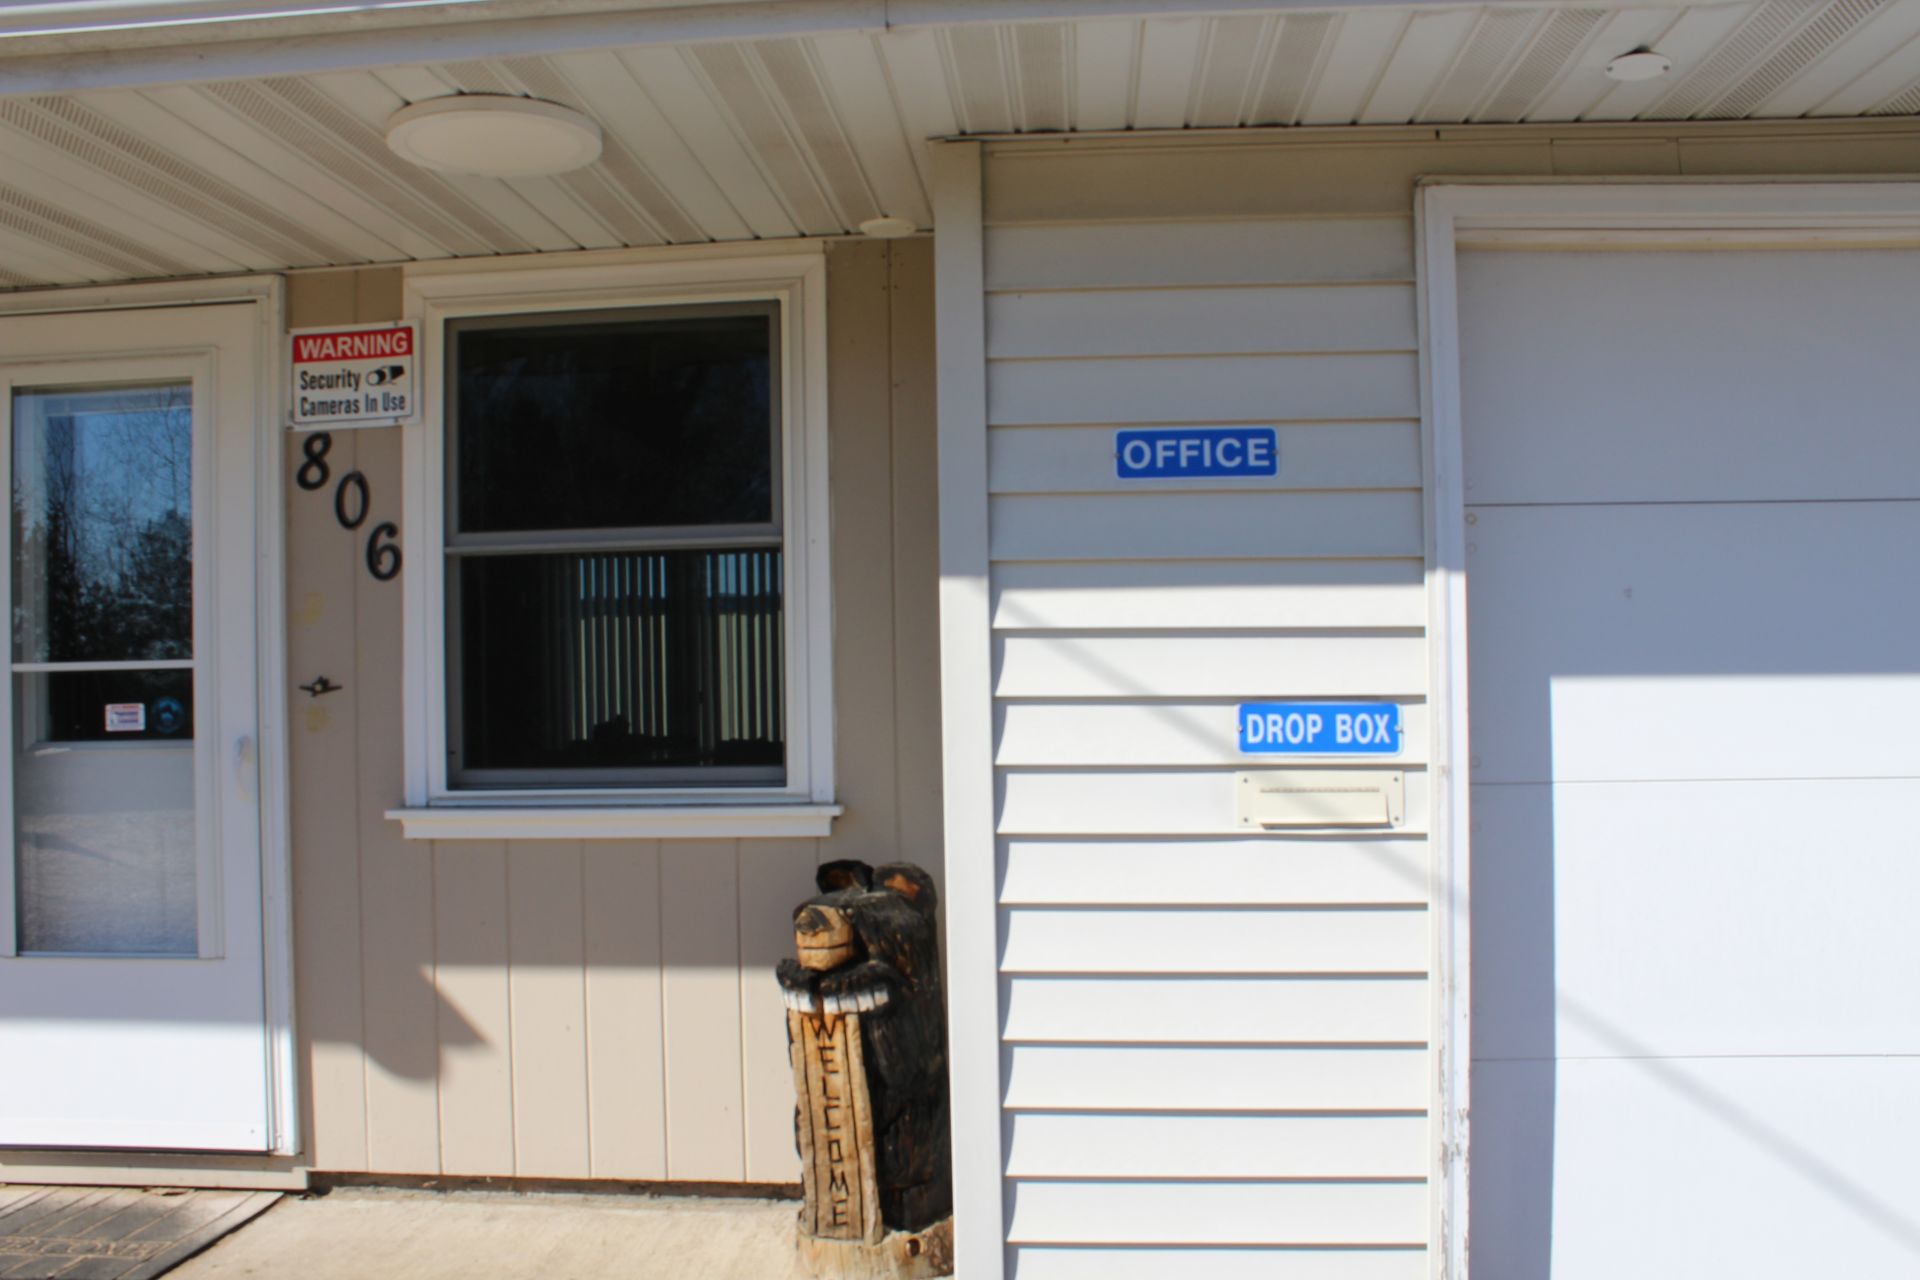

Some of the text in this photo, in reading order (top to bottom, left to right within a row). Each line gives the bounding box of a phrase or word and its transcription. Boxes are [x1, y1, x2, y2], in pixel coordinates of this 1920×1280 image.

[299, 332, 408, 360] WARNING
[300, 368, 361, 392] Security
[300, 391, 406, 417] Cameras In Use
[1123, 437, 1270, 469] OFFICE
[296, 431, 403, 581] 806
[1246, 712, 1391, 744] DROP BOX
[808, 1014, 850, 1227] WELCOME
